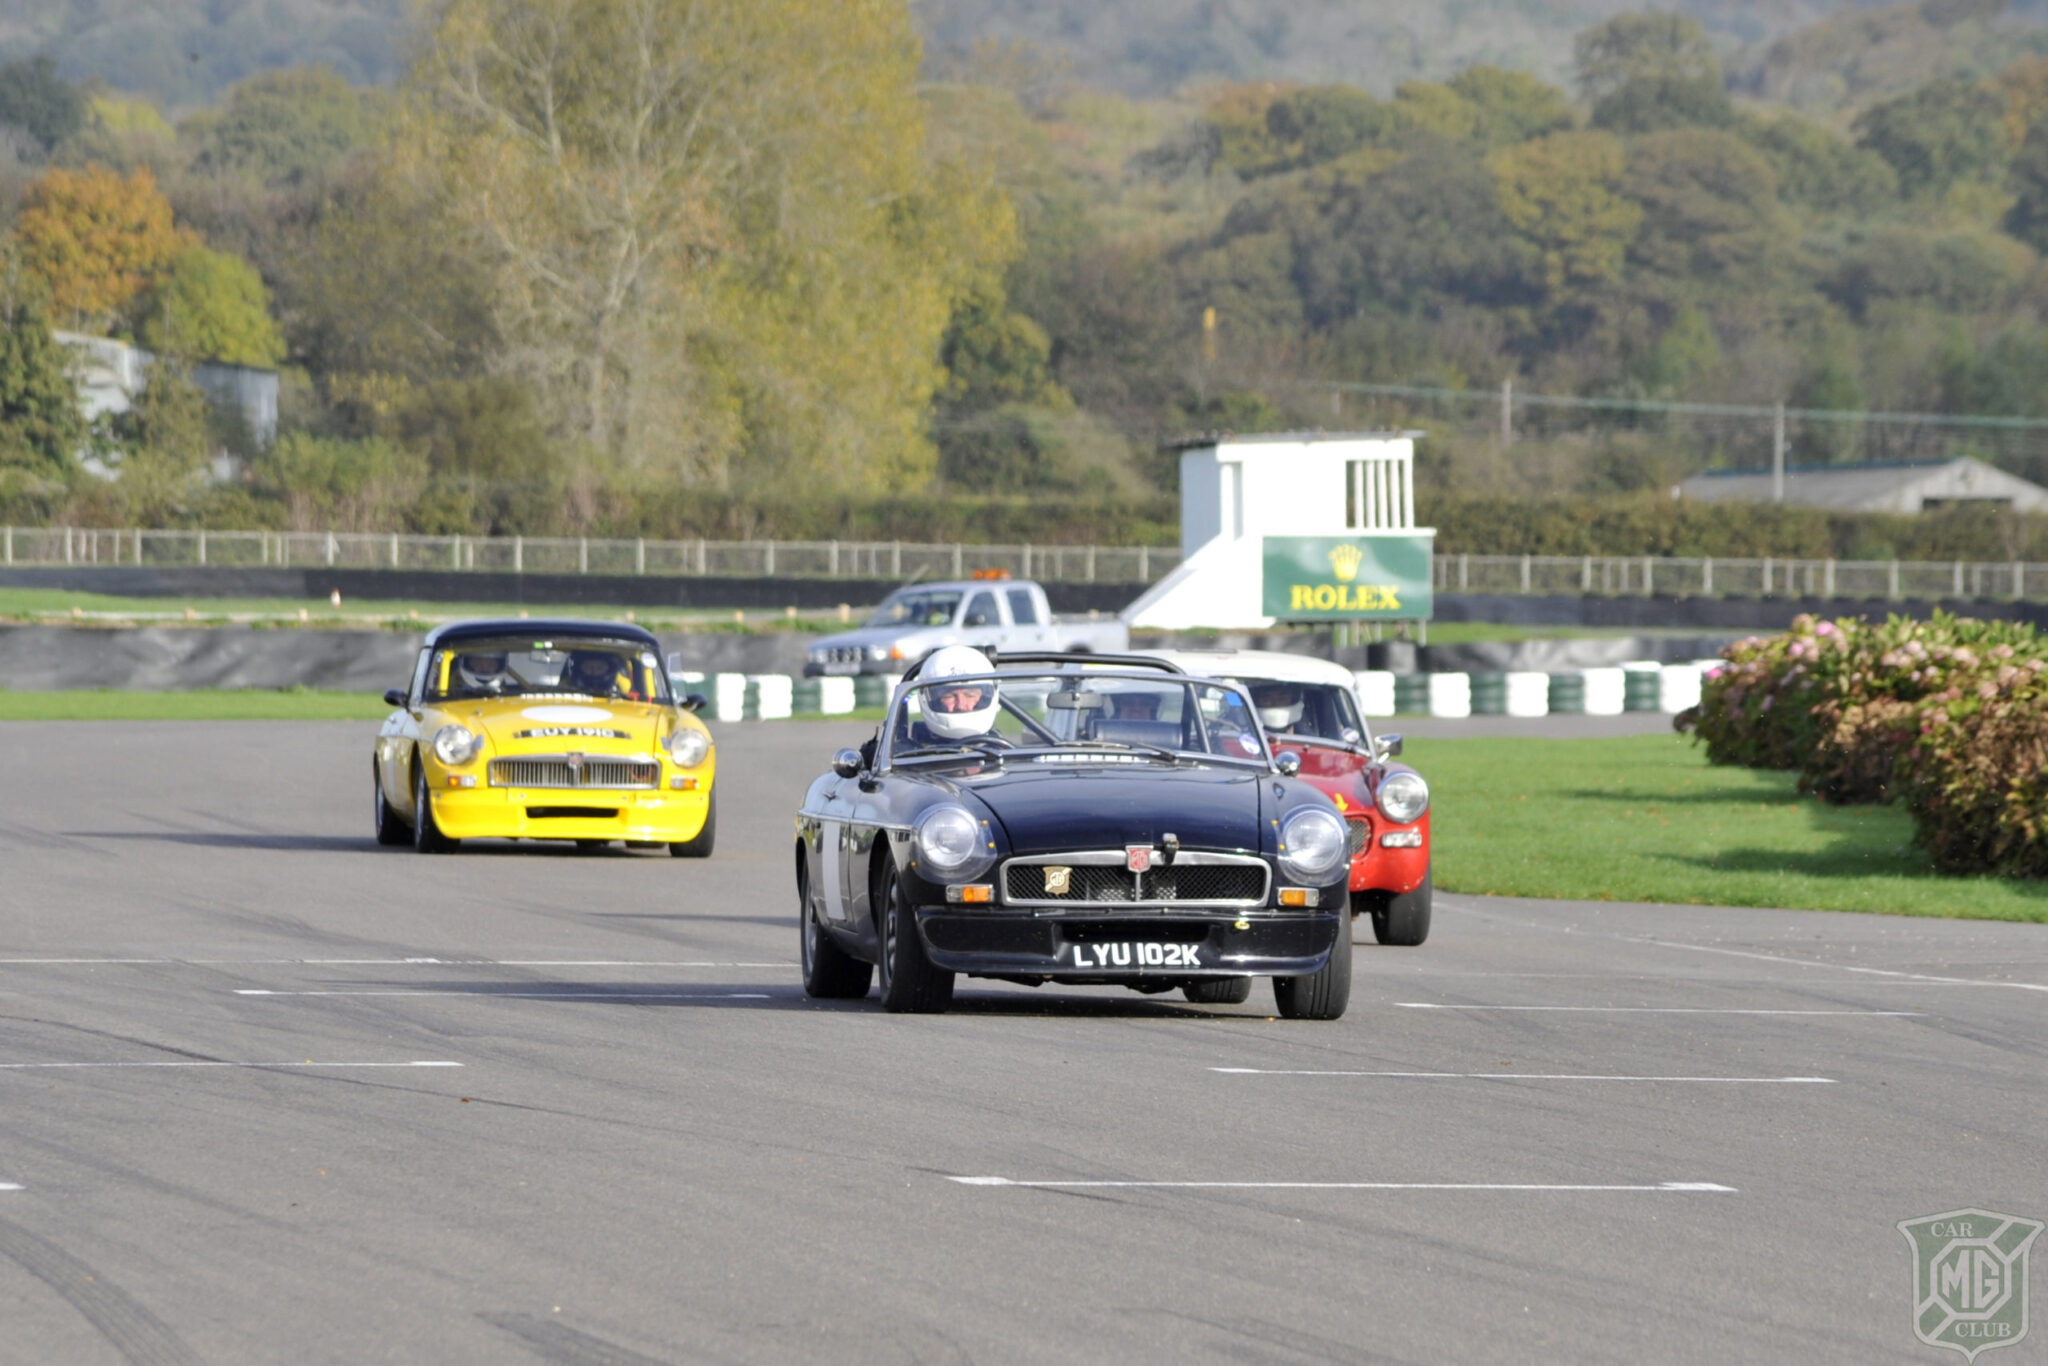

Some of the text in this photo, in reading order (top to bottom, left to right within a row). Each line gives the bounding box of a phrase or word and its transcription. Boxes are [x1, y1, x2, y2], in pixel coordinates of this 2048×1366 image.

[1291, 584, 1401, 611] ROLEX
[1073, 942, 1201, 967] LYU 102K
